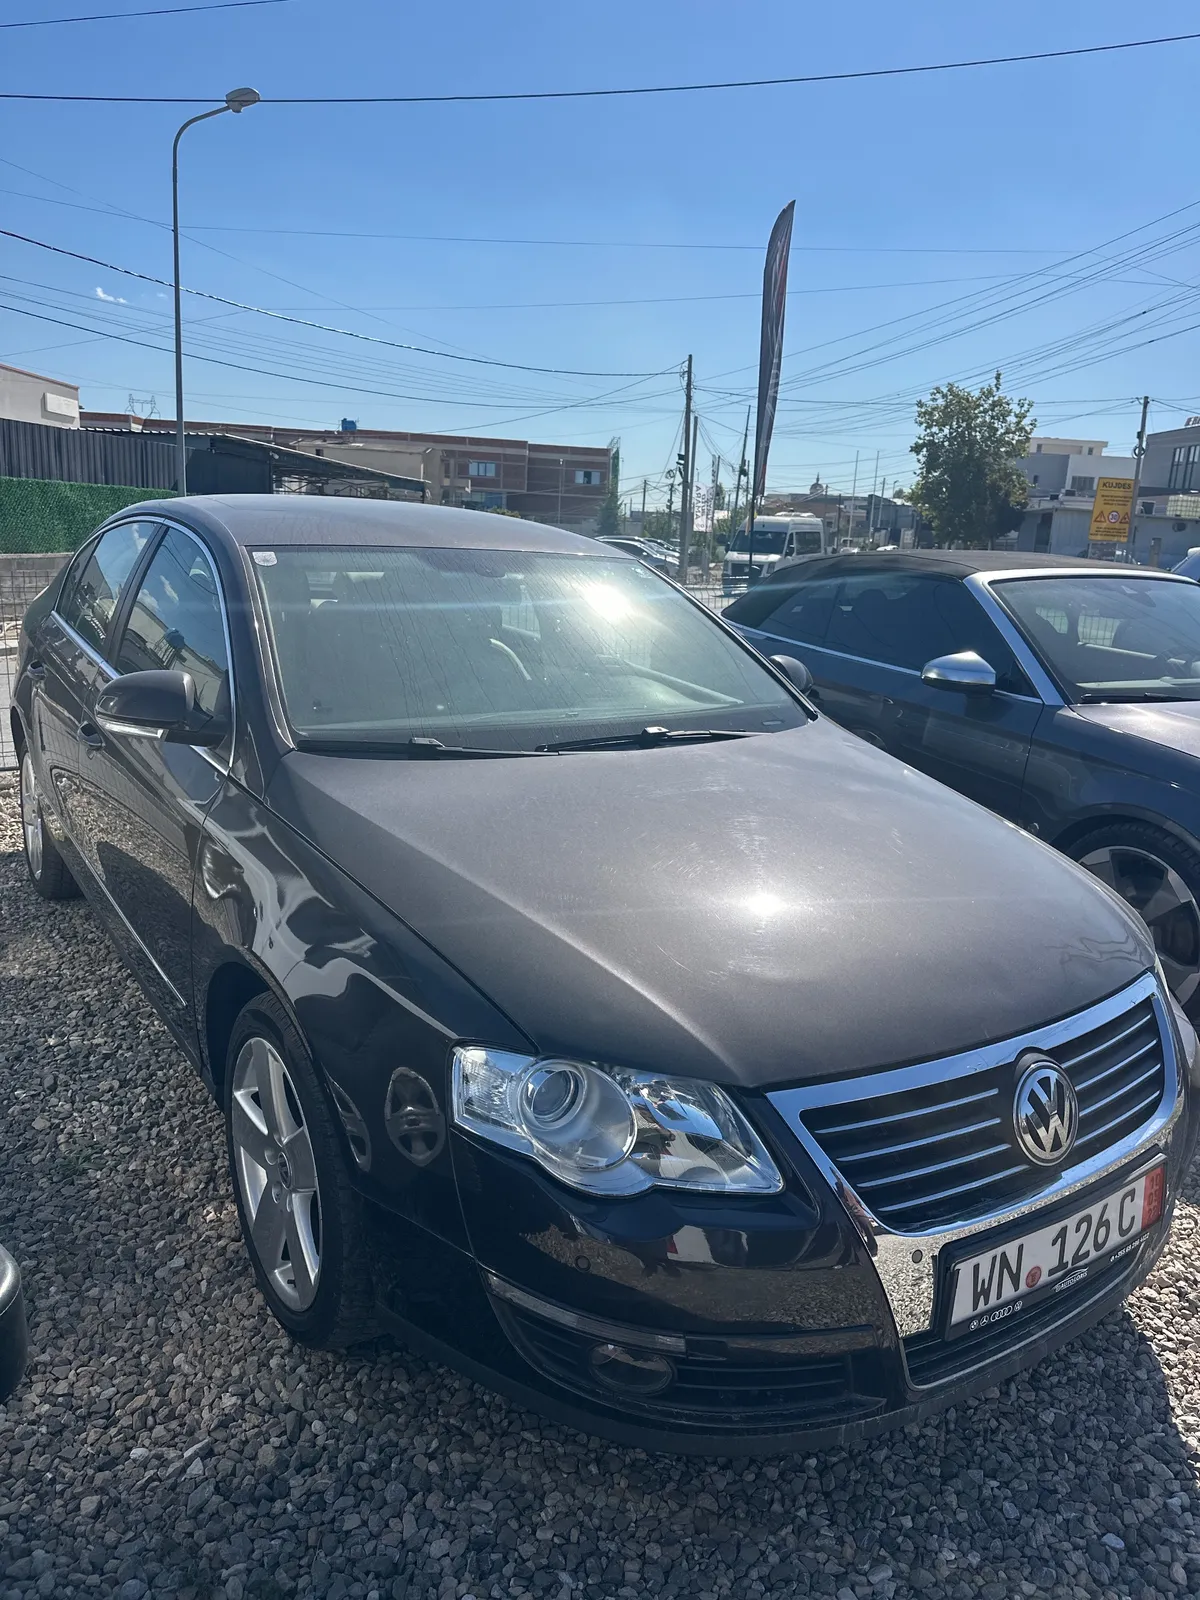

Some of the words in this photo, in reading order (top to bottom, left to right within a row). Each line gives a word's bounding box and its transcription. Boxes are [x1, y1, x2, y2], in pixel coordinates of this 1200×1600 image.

[972, 1244, 1024, 1312] WN
[1048, 1202, 1111, 1277] 126
[1118, 1188, 1136, 1237] C
